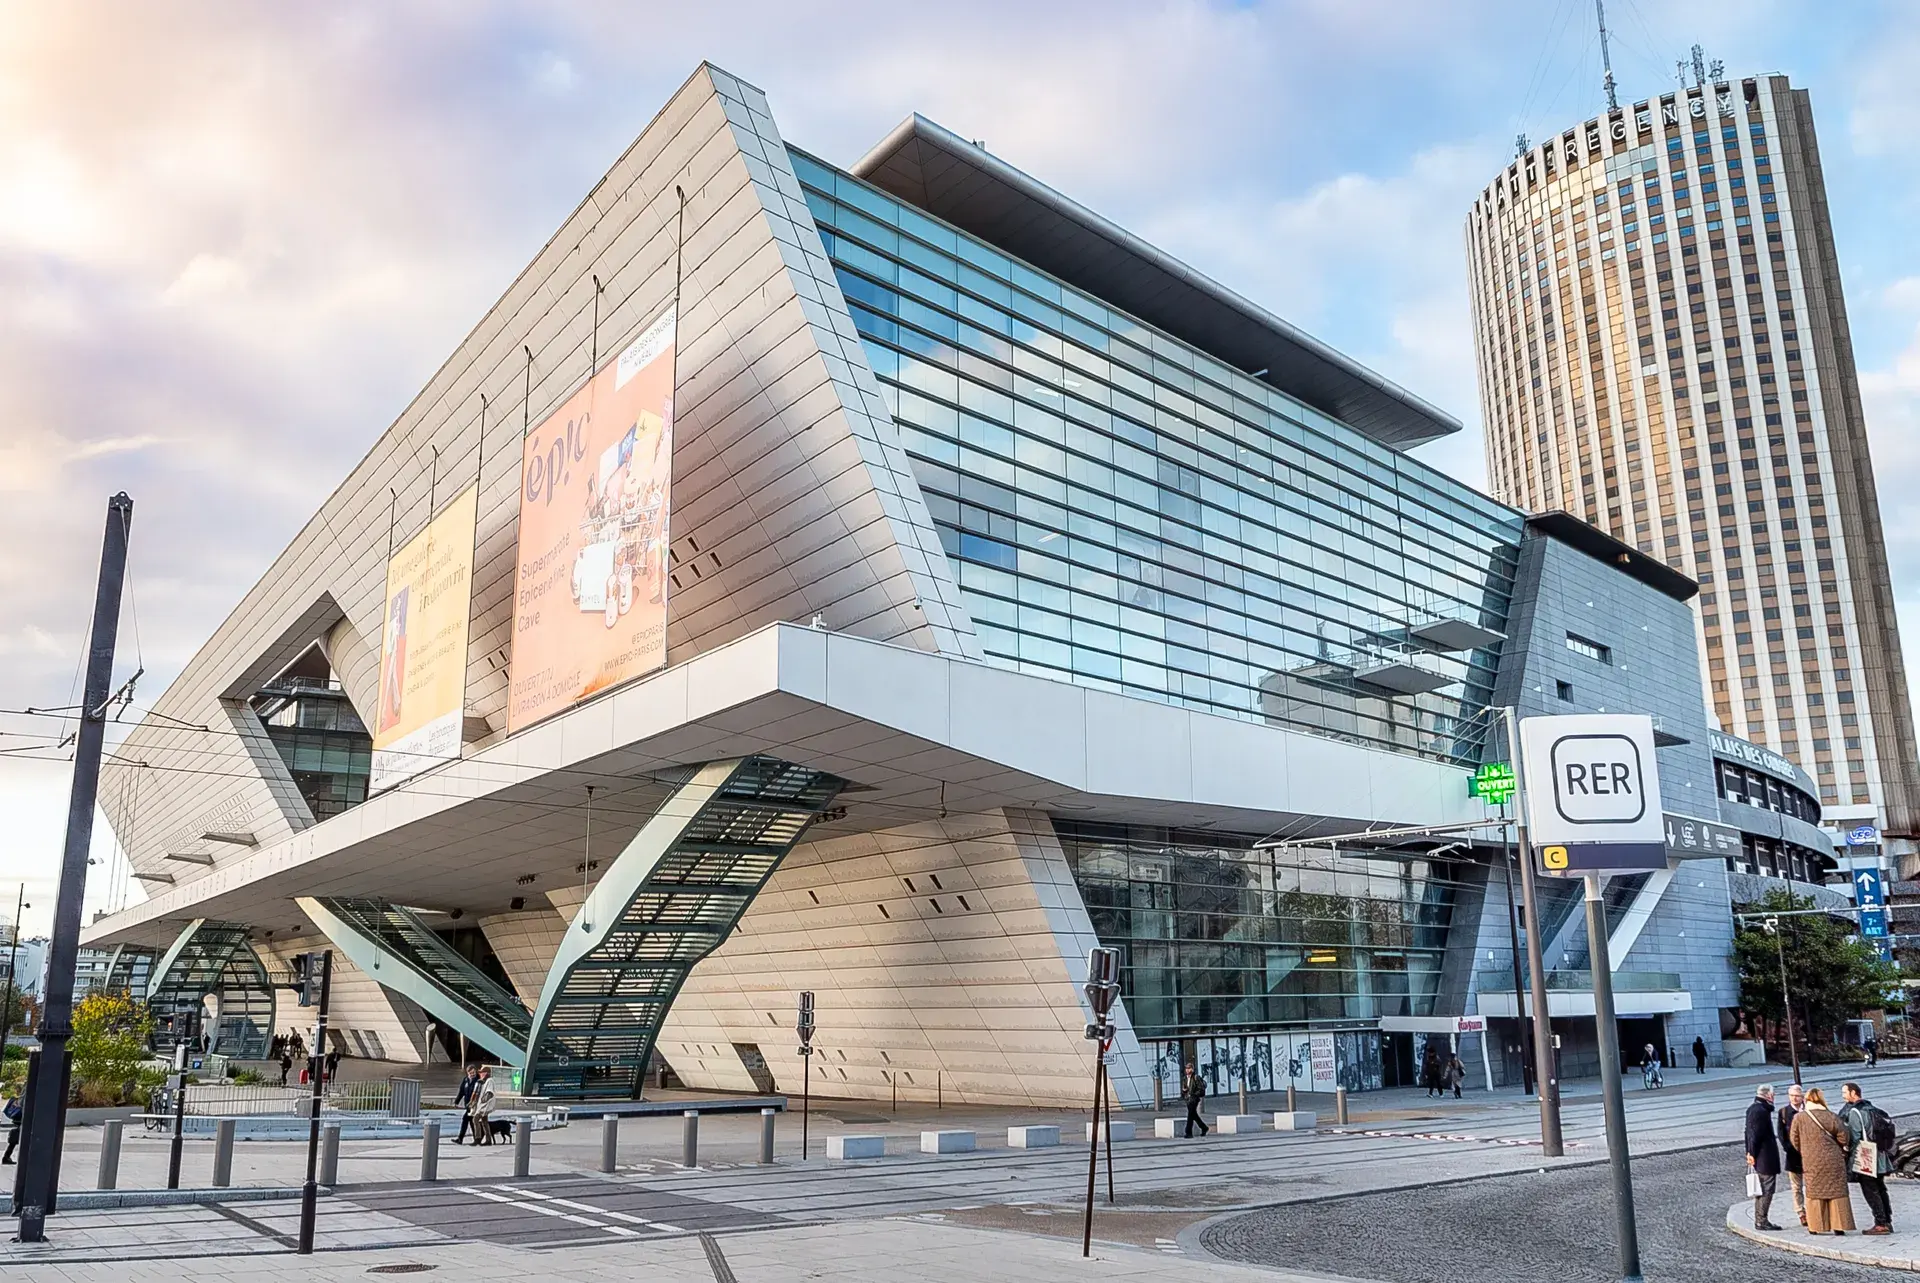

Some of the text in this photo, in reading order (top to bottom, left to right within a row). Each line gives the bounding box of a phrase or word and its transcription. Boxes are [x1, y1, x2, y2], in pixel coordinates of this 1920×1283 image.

[1477, 92, 1735, 227] HYATT REGENCY
[518, 611, 540, 633] Cave
[512, 690, 546, 717] LIVRAISON
[552, 671, 581, 698] DOMICILE
[514, 672, 541, 696] OUVERT
[1711, 734, 1743, 759] ALAIS
[1744, 744, 1763, 766] DES
[1478, 779, 1514, 791] OUVERT
[1566, 763, 1632, 795] RER
[269, 834, 314, 870] PARIS
[1551, 851, 1561, 863] C
